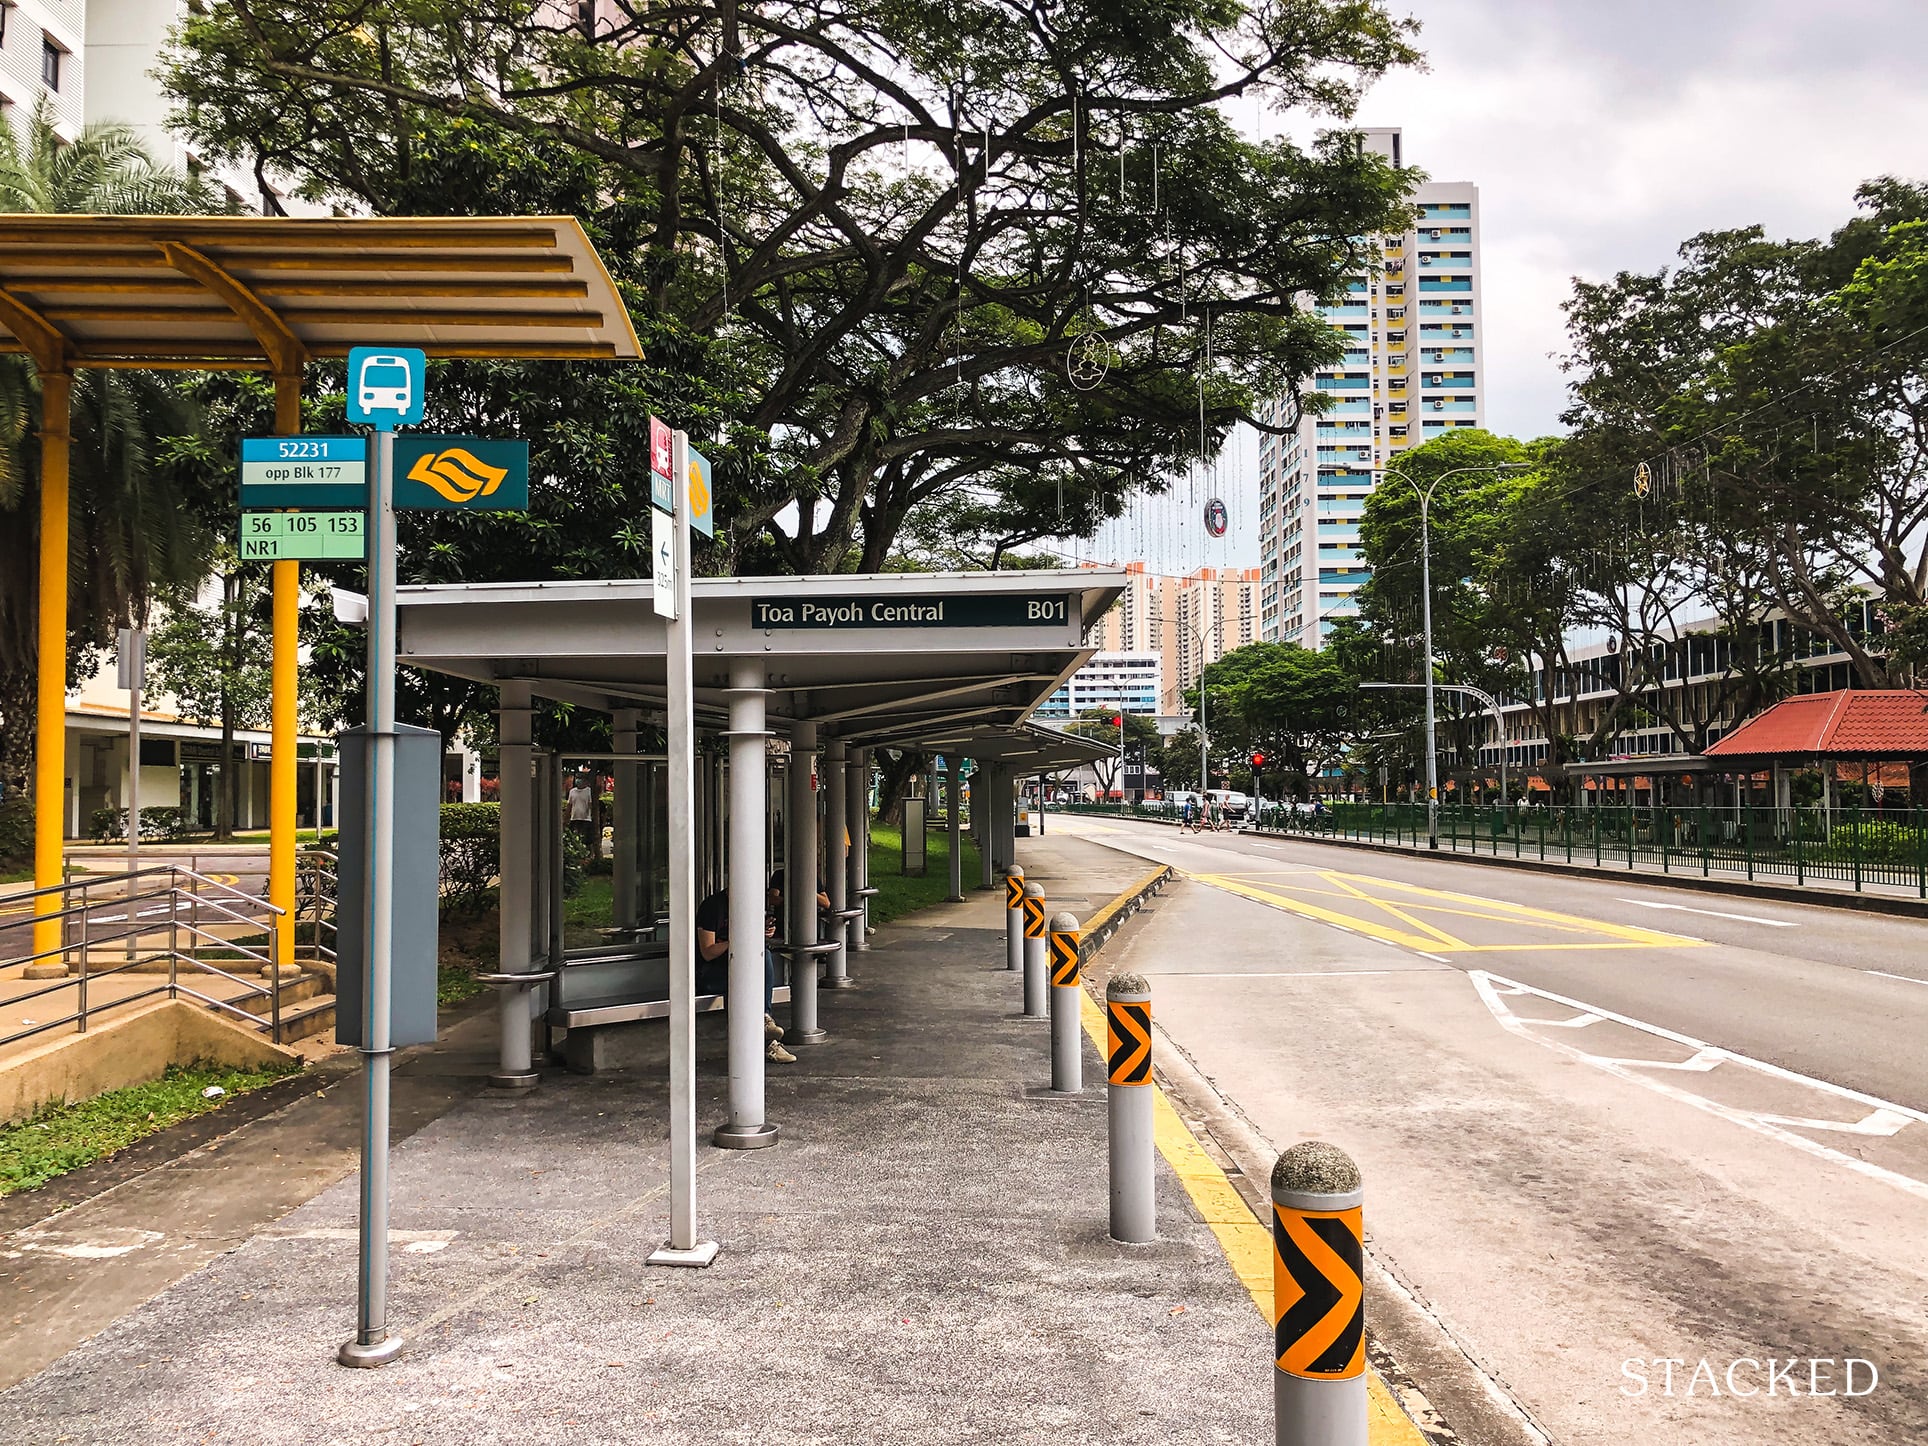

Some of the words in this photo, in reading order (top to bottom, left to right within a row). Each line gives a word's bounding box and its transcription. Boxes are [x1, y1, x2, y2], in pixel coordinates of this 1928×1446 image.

[279, 442, 328, 457] 52231
[265, 469, 290, 480] opp
[294, 466, 314, 478] Blk
[318, 467, 341, 478] 177
[655, 476, 671, 502] MRT
[252, 518, 272, 533] 56
[287, 517, 317, 532] 105
[328, 517, 358, 532] 153
[246, 540, 278, 555] NR1
[757, 603, 793, 622] Toa
[802, 602, 863, 626] Payoh
[871, 601, 943, 622] Central
[1028, 601, 1065, 620] B01
